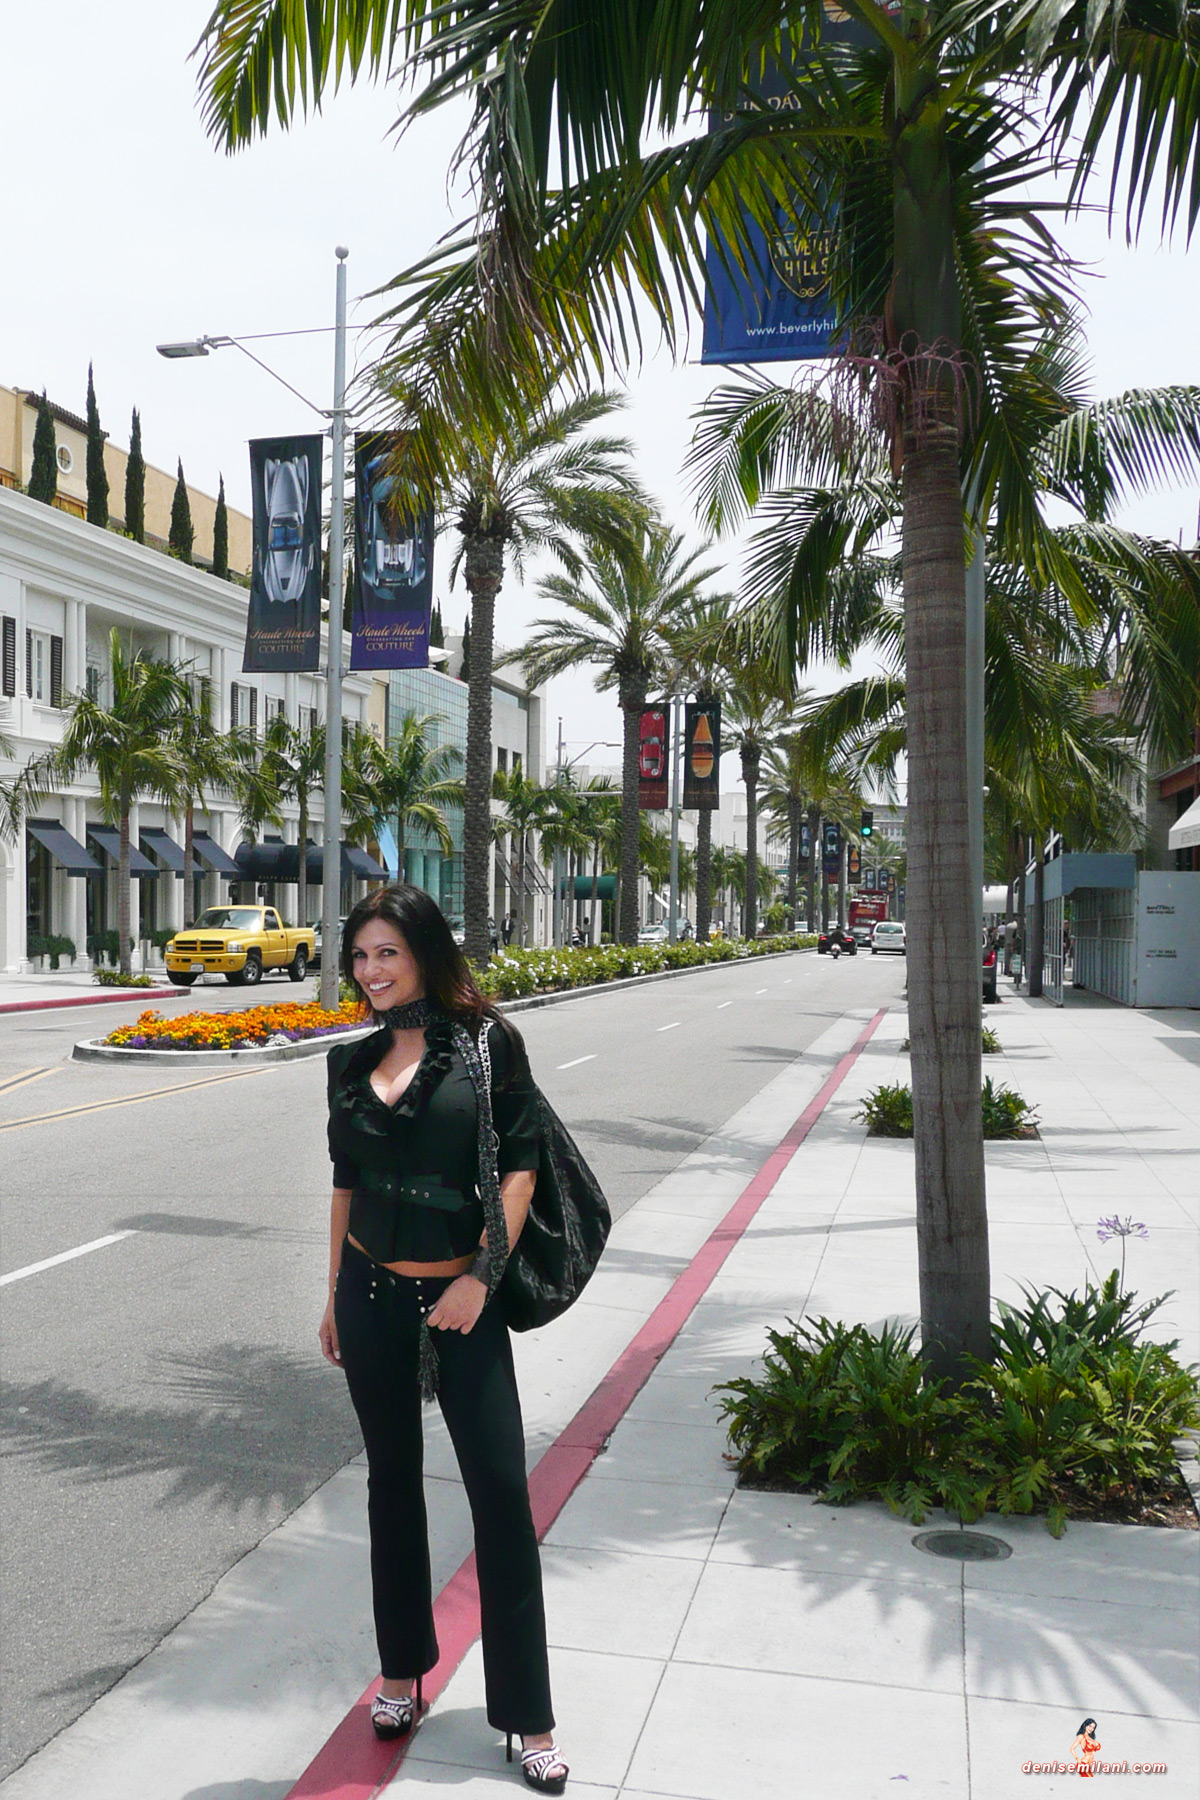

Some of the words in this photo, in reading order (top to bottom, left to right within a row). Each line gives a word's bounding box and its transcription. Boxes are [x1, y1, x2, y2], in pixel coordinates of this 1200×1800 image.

[785, 257, 828, 277] HILLS
[250, 627, 282, 640] Haute
[283, 623, 315, 639] Wheels
[356, 624, 390, 637] Haute
[391, 620, 425, 636] Wheels
[259, 644, 305, 655] COUTURE
[366, 642, 415, 652] COUTURE
